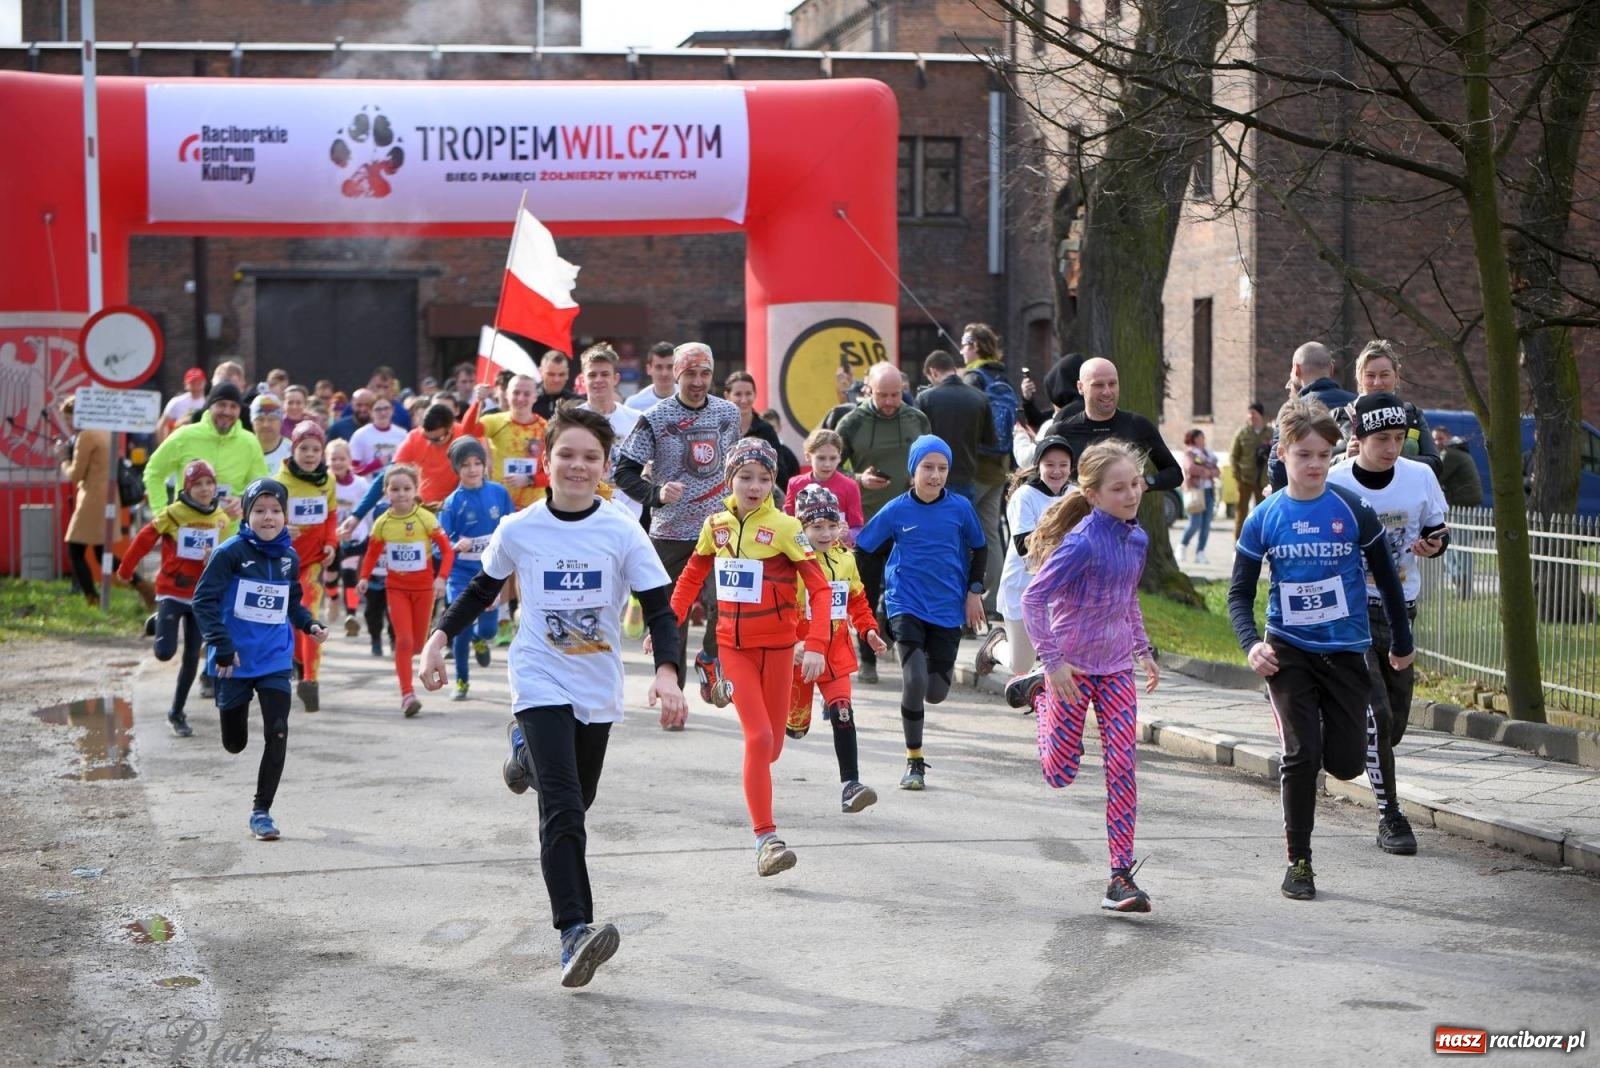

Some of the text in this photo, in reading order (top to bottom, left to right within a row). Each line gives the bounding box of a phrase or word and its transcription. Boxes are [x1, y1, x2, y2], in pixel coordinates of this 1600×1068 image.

[201, 125, 288, 143] Raciborskie
[201, 163, 256, 184] Kultury
[445, 168, 698, 184] BIEG PAMIĘCI ŻOŁNIERZY WYKLĘTYCH
[1362, 417, 1387, 432] WEST
[396, 551, 416, 561] 100
[560, 572, 585, 589] 44
[725, 571, 740, 586] 70
[257, 595, 276, 609] 63
[1301, 594, 1323, 611] 33
